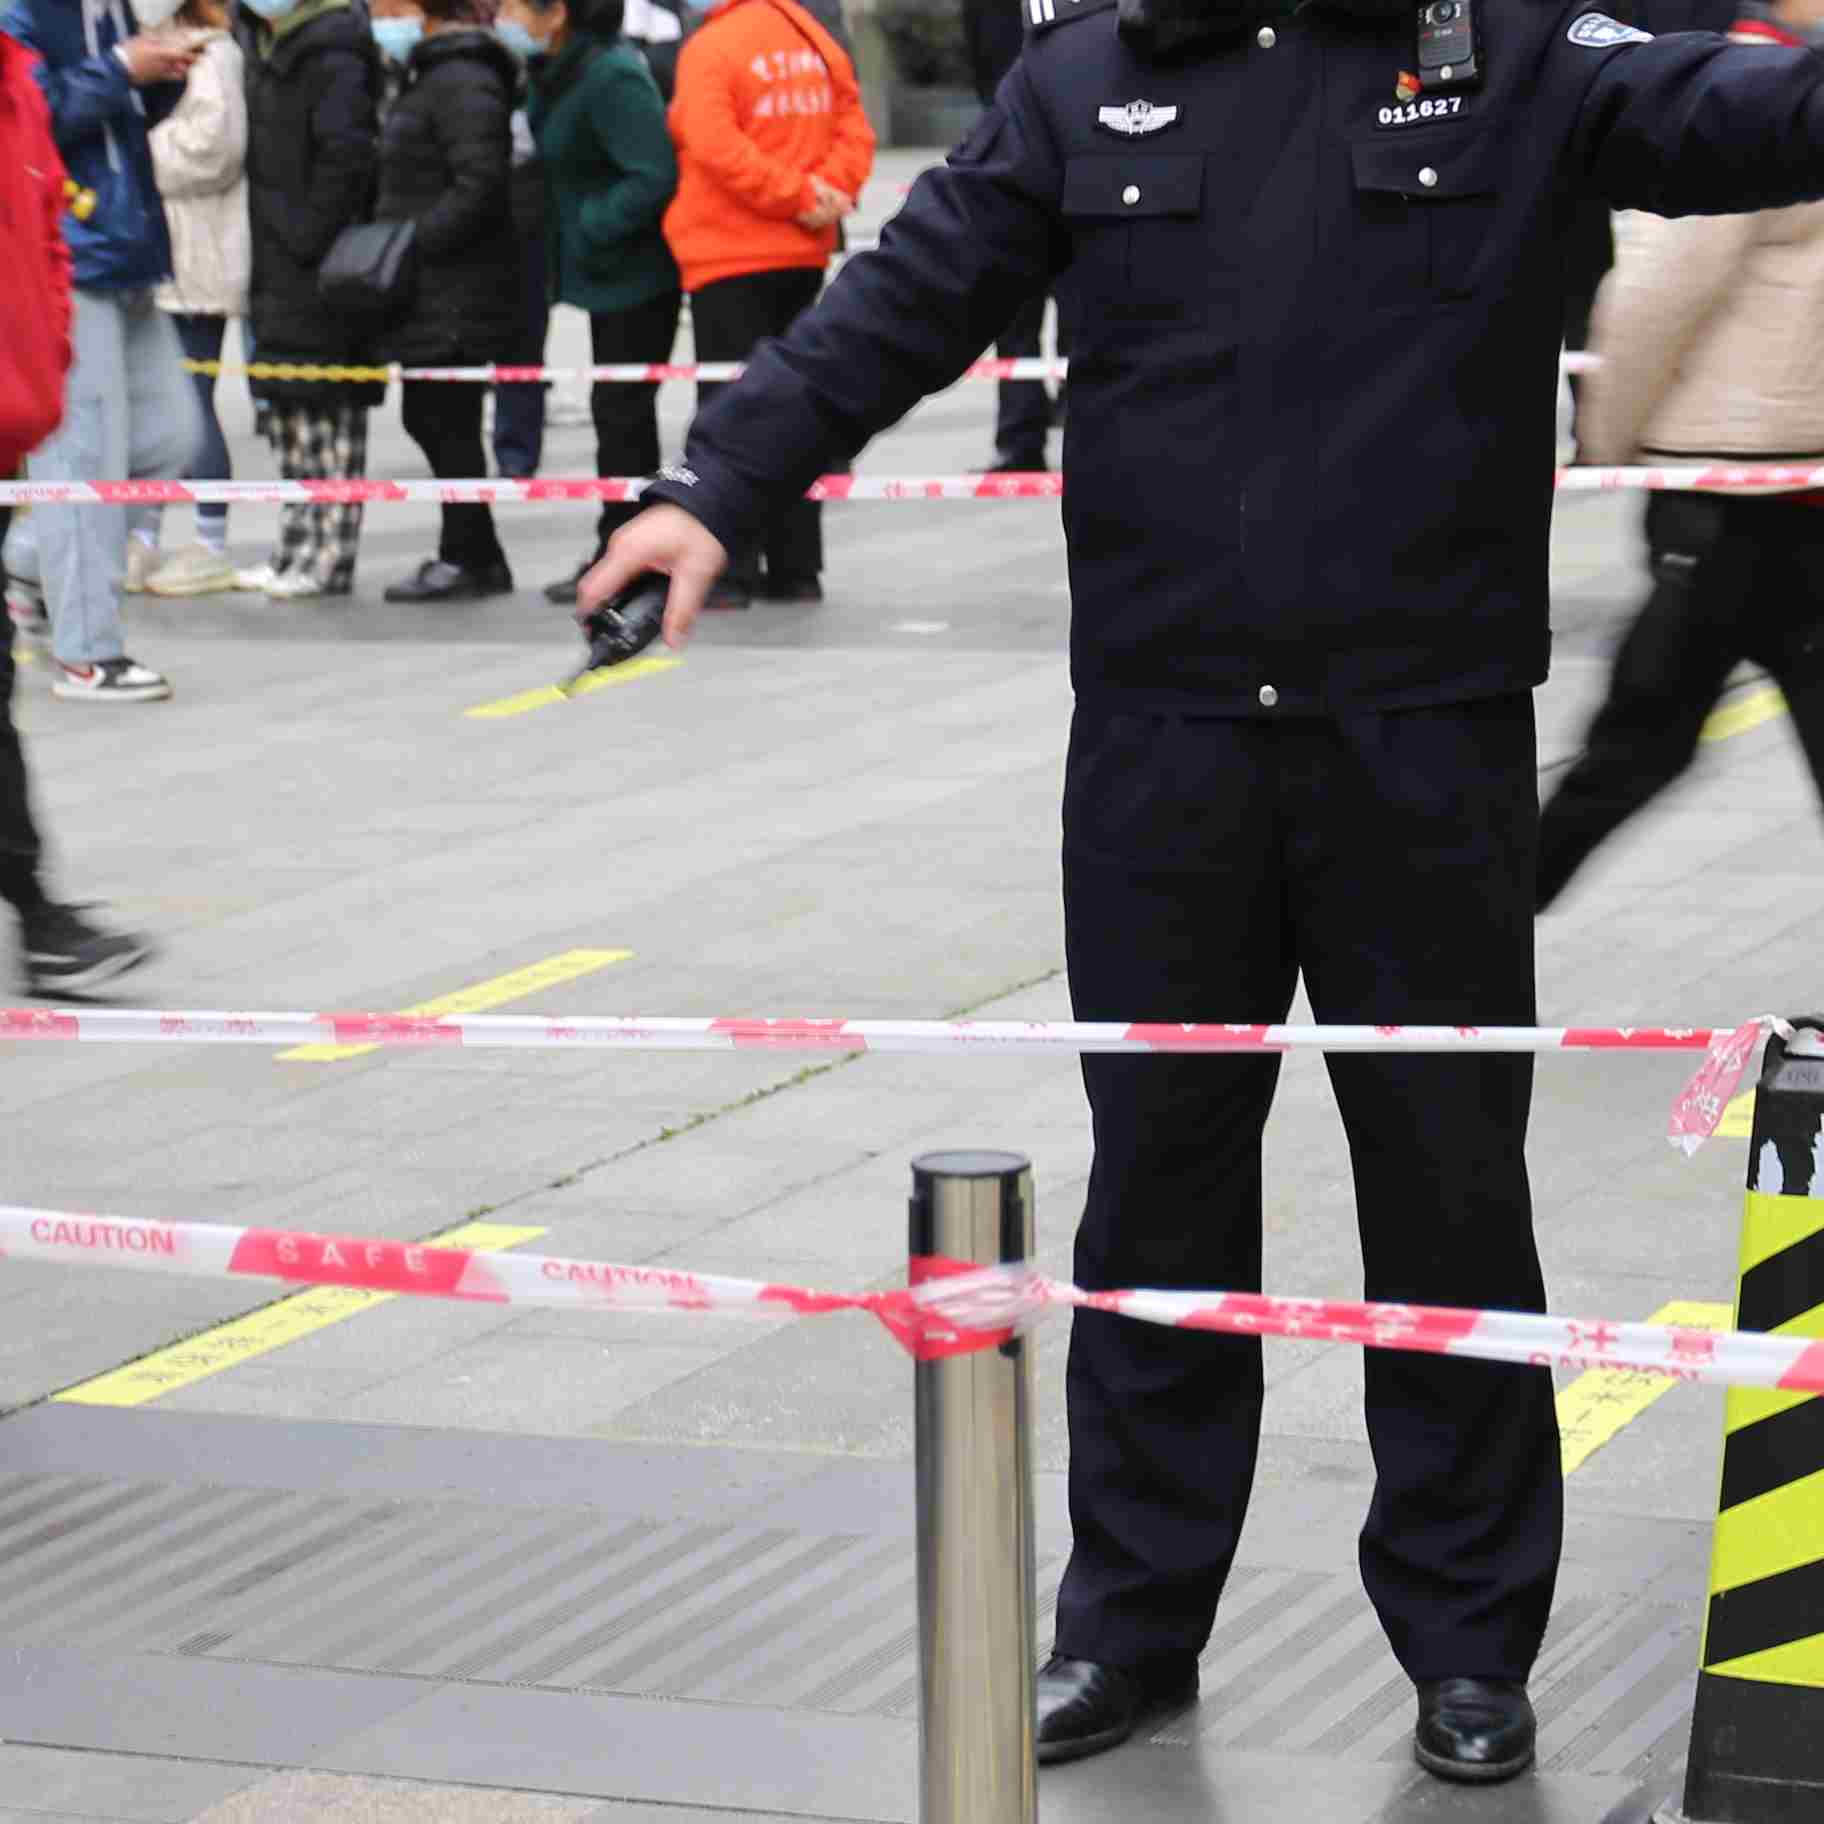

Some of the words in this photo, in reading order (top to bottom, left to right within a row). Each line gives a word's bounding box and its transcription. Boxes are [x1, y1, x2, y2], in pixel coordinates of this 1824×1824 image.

[1378, 96, 1462, 125] 011627
[30, 1218, 175, 1256] CAUTION
[277, 1236, 427, 1273] SAFE
